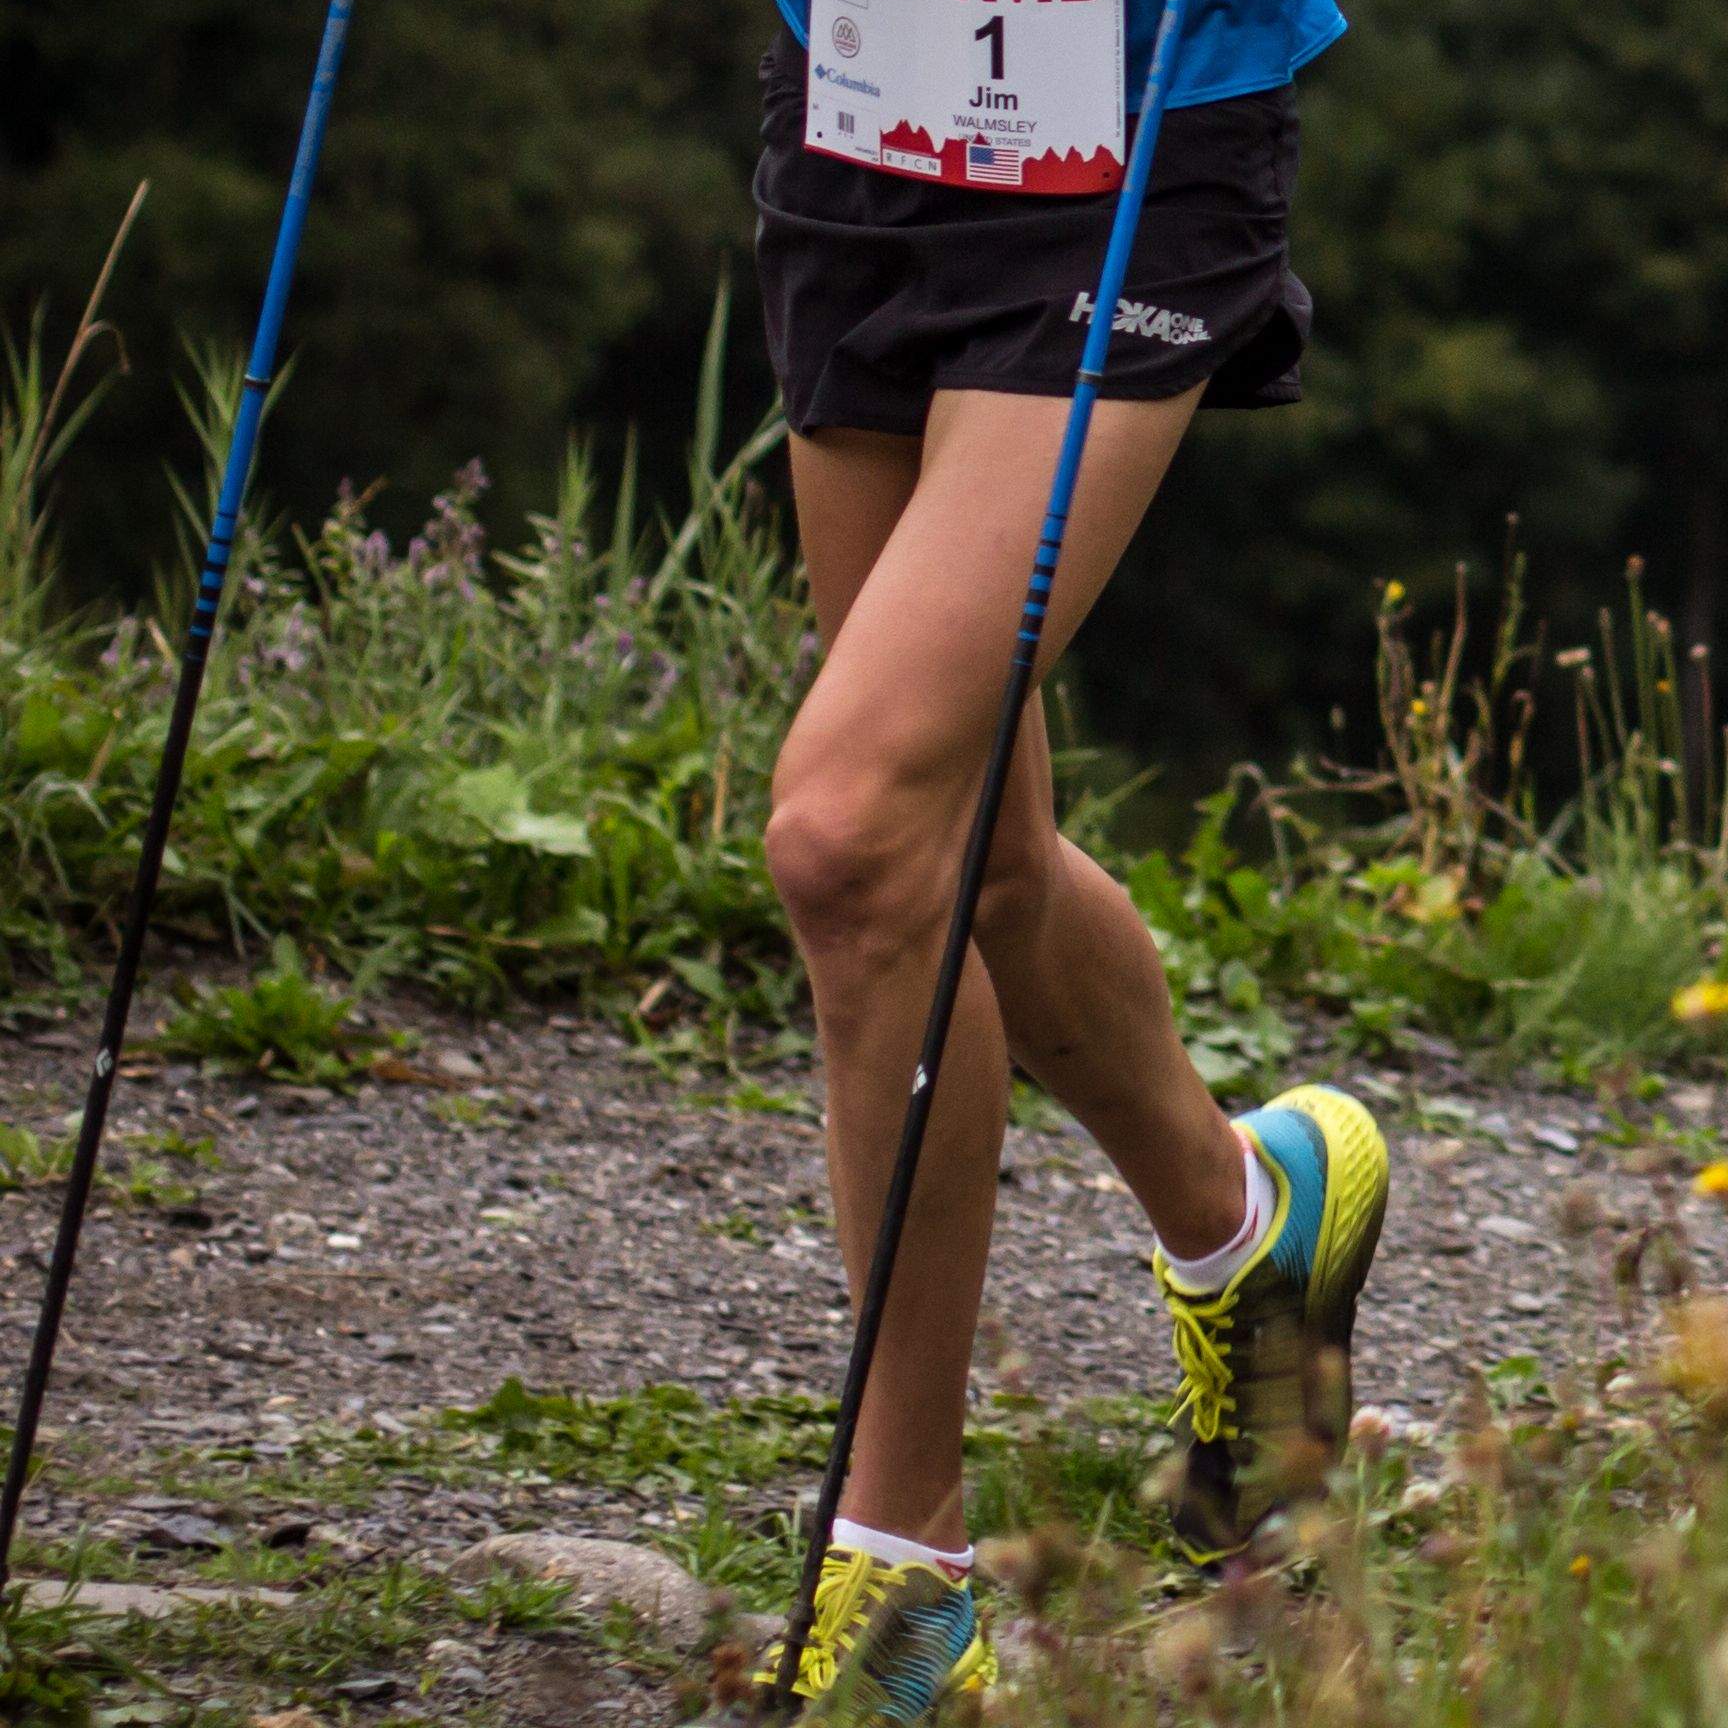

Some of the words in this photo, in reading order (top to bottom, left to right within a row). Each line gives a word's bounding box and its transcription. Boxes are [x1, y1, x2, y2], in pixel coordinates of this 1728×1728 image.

[975, 15, 1005, 81] 1
[969, 85, 1019, 111] Jim
[952, 114, 1038, 134] WALMSLEY
